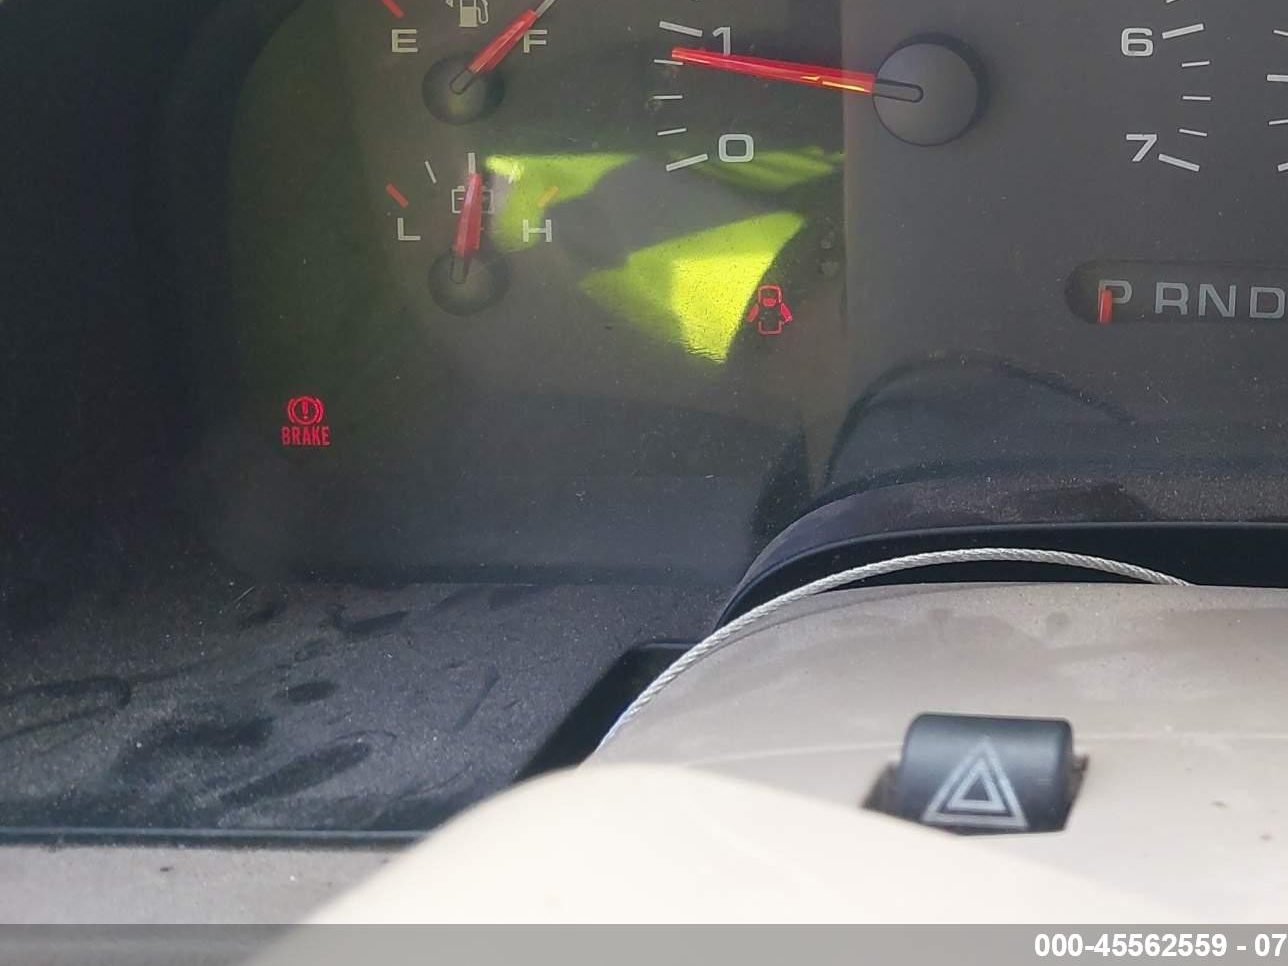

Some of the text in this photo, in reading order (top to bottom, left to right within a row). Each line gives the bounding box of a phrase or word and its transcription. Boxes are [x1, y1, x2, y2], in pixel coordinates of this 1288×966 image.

[392, 28, 418, 53] E
[522, 29, 548, 53] F
[711, 26, 731, 56] 1
[1120, 27, 1155, 57] 6
[718, 132, 755, 163] 0
[1125, 133, 1158, 163] 7
[397, 217, 422, 241] L
[522, 218, 552, 243] H
[281, 425, 331, 446] BRAKE
